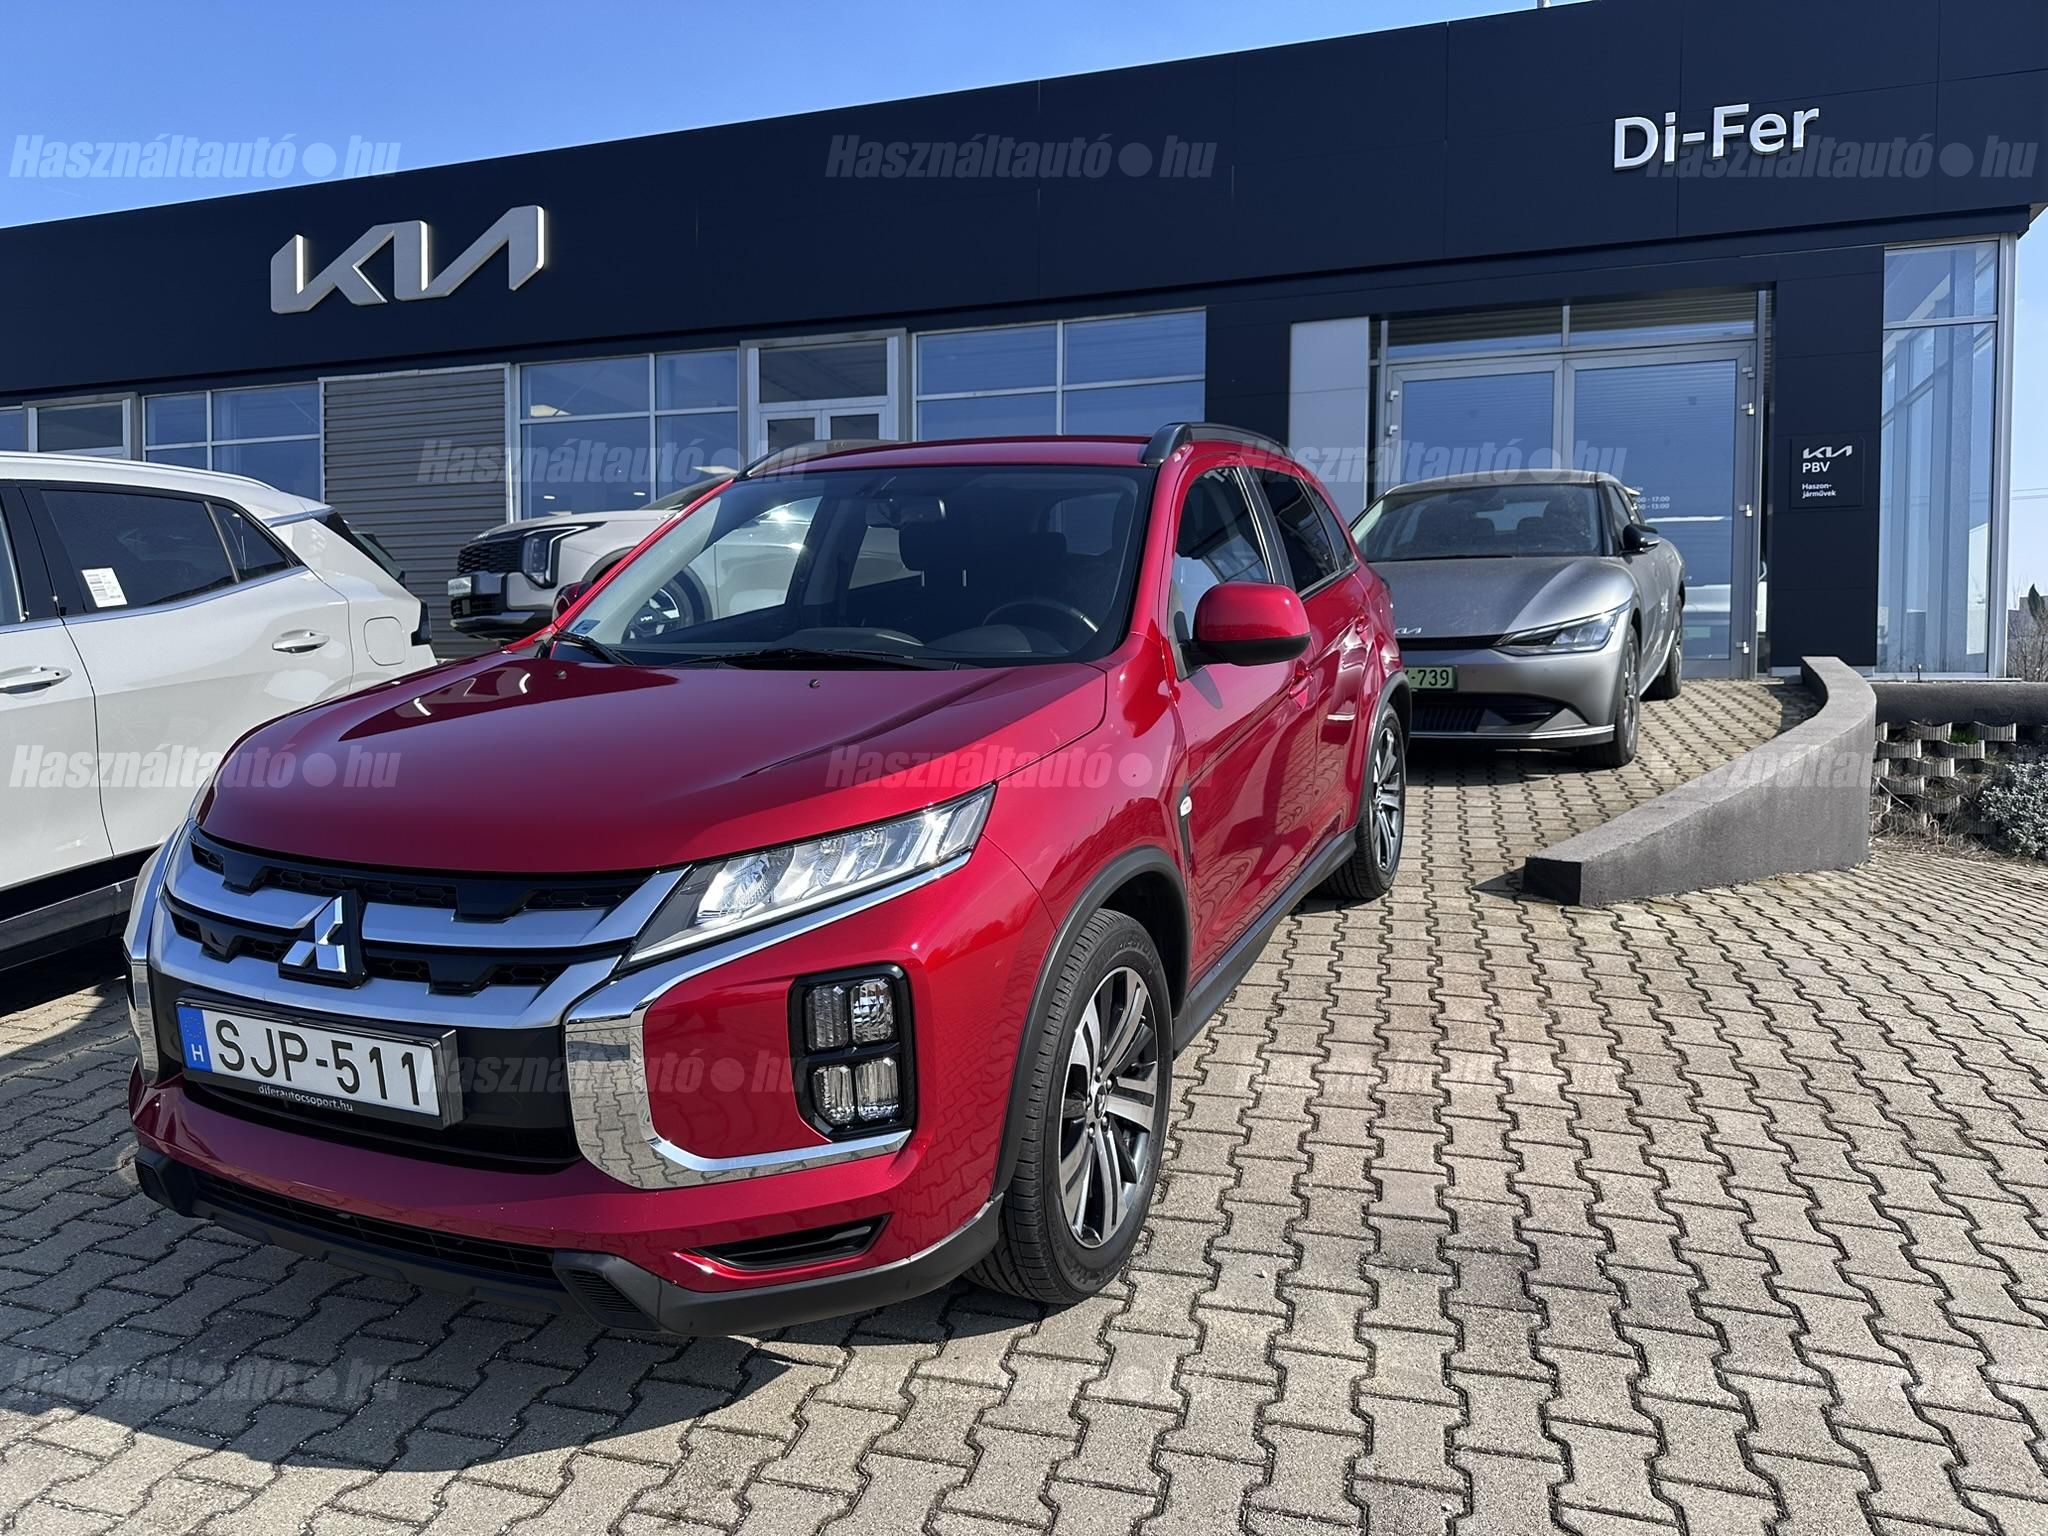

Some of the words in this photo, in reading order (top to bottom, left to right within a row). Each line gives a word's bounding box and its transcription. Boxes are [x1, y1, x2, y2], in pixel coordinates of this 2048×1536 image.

[1613, 103, 1820, 170] Di-Fer
[270, 204, 545, 314] KIA
[1802, 445, 1853, 459] KIA
[1802, 461, 1831, 473] PBV
[1405, 669, 1450, 687] -739
[192, 1044, 205, 1063] H
[215, 1019, 421, 1106] SJP-511
[258, 1084, 354, 1112] diferautocsoport.hu
